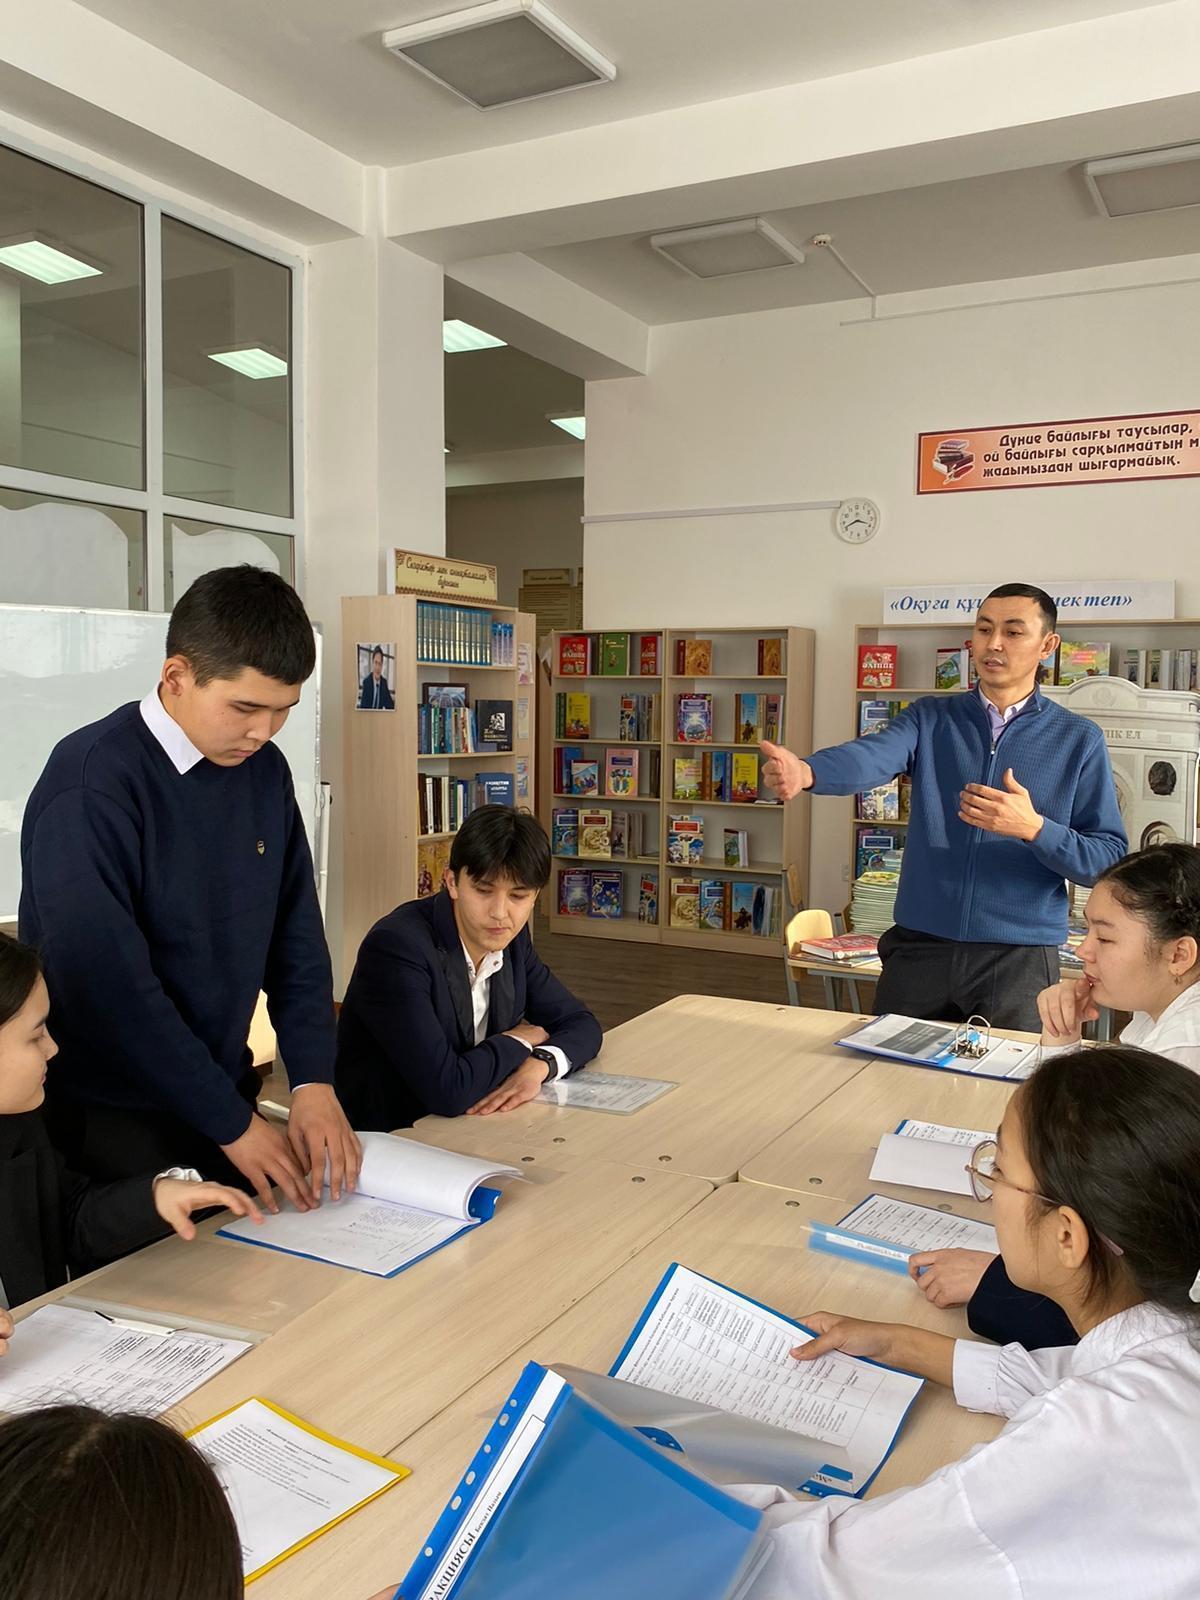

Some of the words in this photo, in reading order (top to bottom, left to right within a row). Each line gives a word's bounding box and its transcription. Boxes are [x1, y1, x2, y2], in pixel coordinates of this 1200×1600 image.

[1047, 430, 1110, 443] байлығы
[1117, 423, 1193, 439] таусылар,
[983, 451, 999, 463] ой
[1005, 448, 1066, 461] байлығы
[1072, 440, 1183, 458] сарқылмайтын
[982, 462, 1073, 478] жадымыздан
[1079, 455, 1180, 471] шығармайық.
